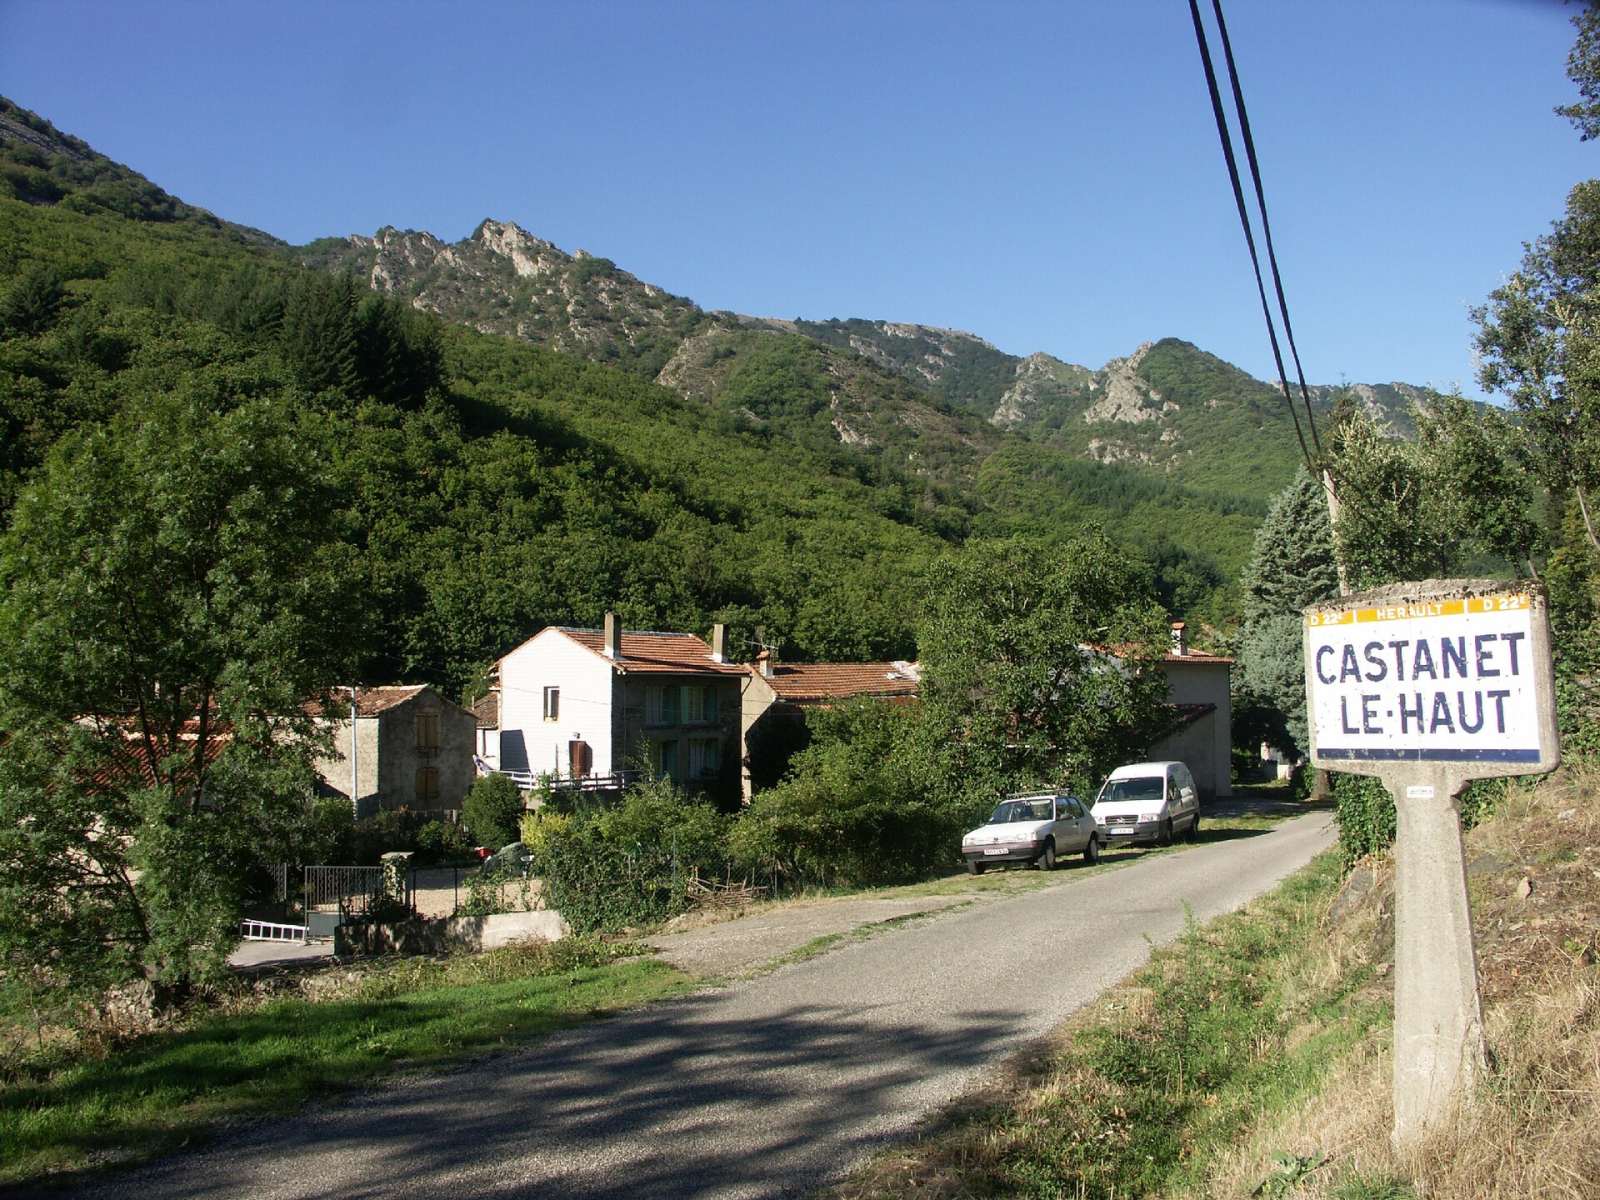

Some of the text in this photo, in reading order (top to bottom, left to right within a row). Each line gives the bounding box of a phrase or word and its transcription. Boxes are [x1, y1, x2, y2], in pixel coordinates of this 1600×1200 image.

[1483, 598, 1493, 611] D
[1310, 614, 1320, 626] D
[1316, 631, 1525, 685] CASTANET
